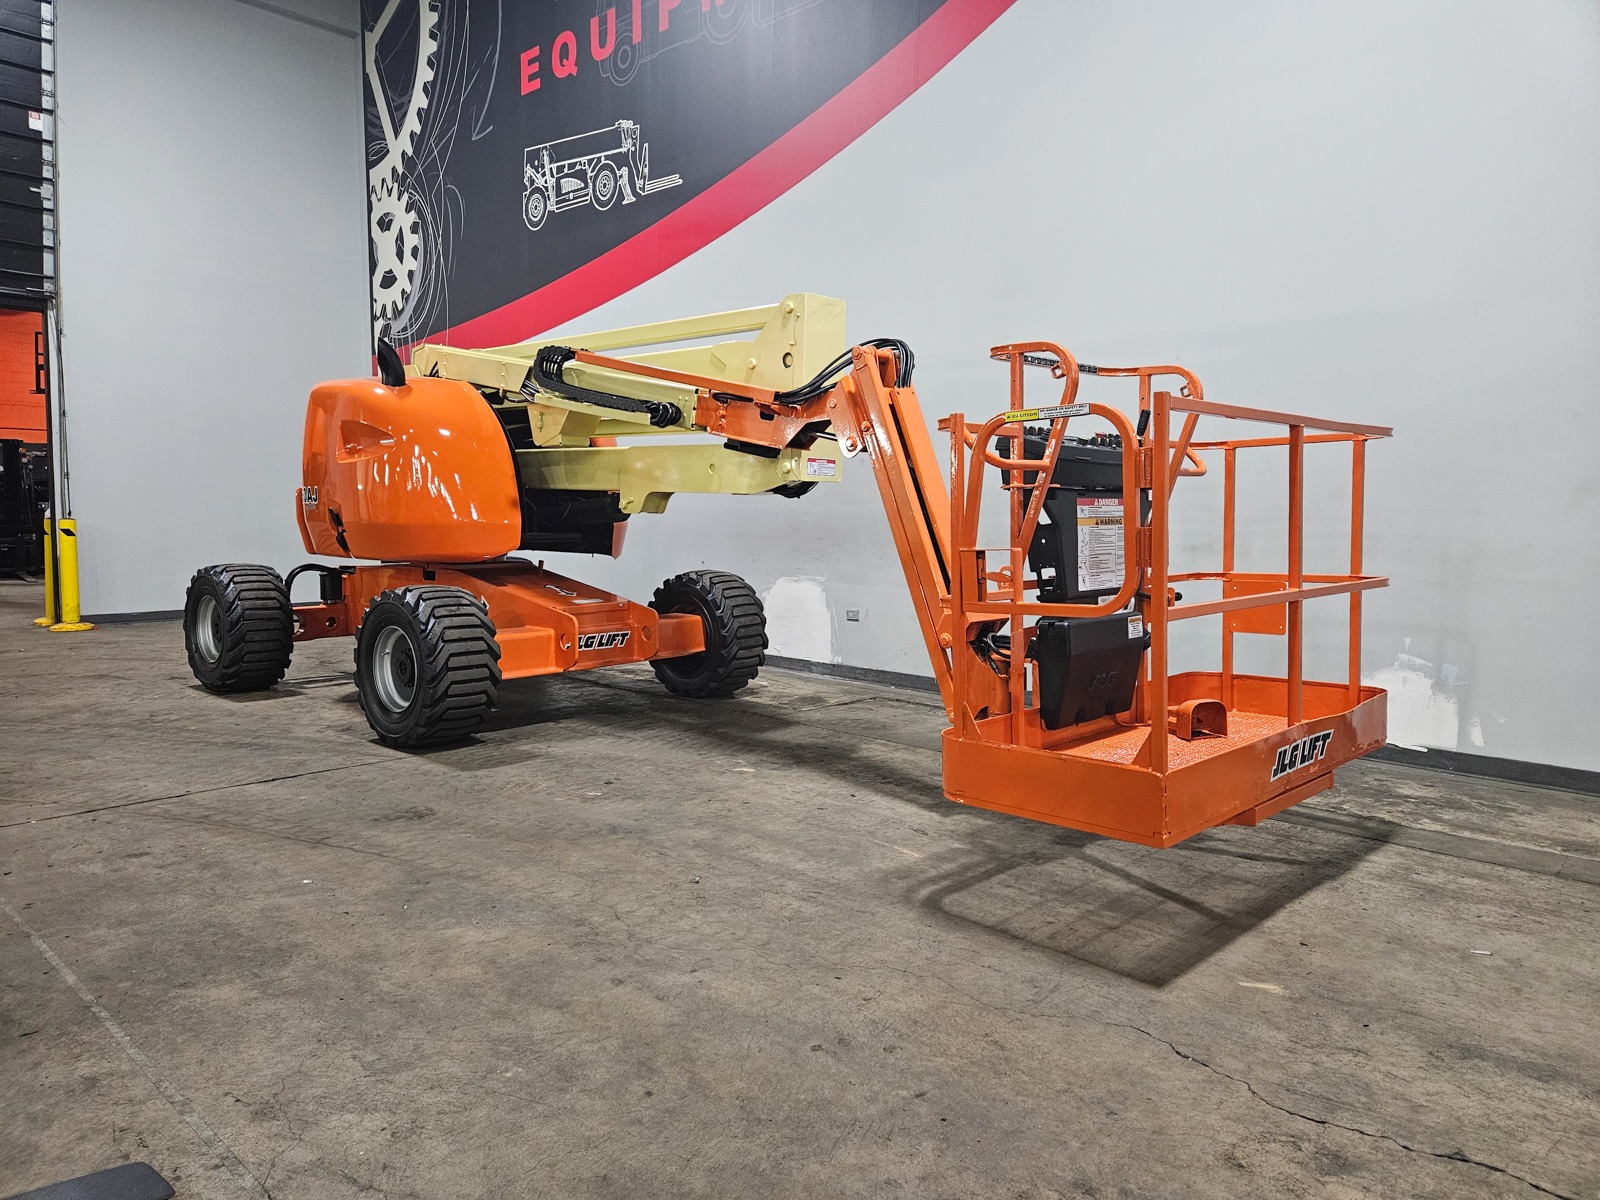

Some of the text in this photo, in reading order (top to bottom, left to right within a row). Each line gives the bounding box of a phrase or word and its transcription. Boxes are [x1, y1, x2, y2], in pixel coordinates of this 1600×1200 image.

[520, 0, 726, 96] EQUIP
[1098, 498, 1119, 506] DANGER
[1099, 518, 1123, 526] WARNING
[564, 631, 631, 651] LG LIFT
[1271, 730, 1334, 782] JLG LIFT
